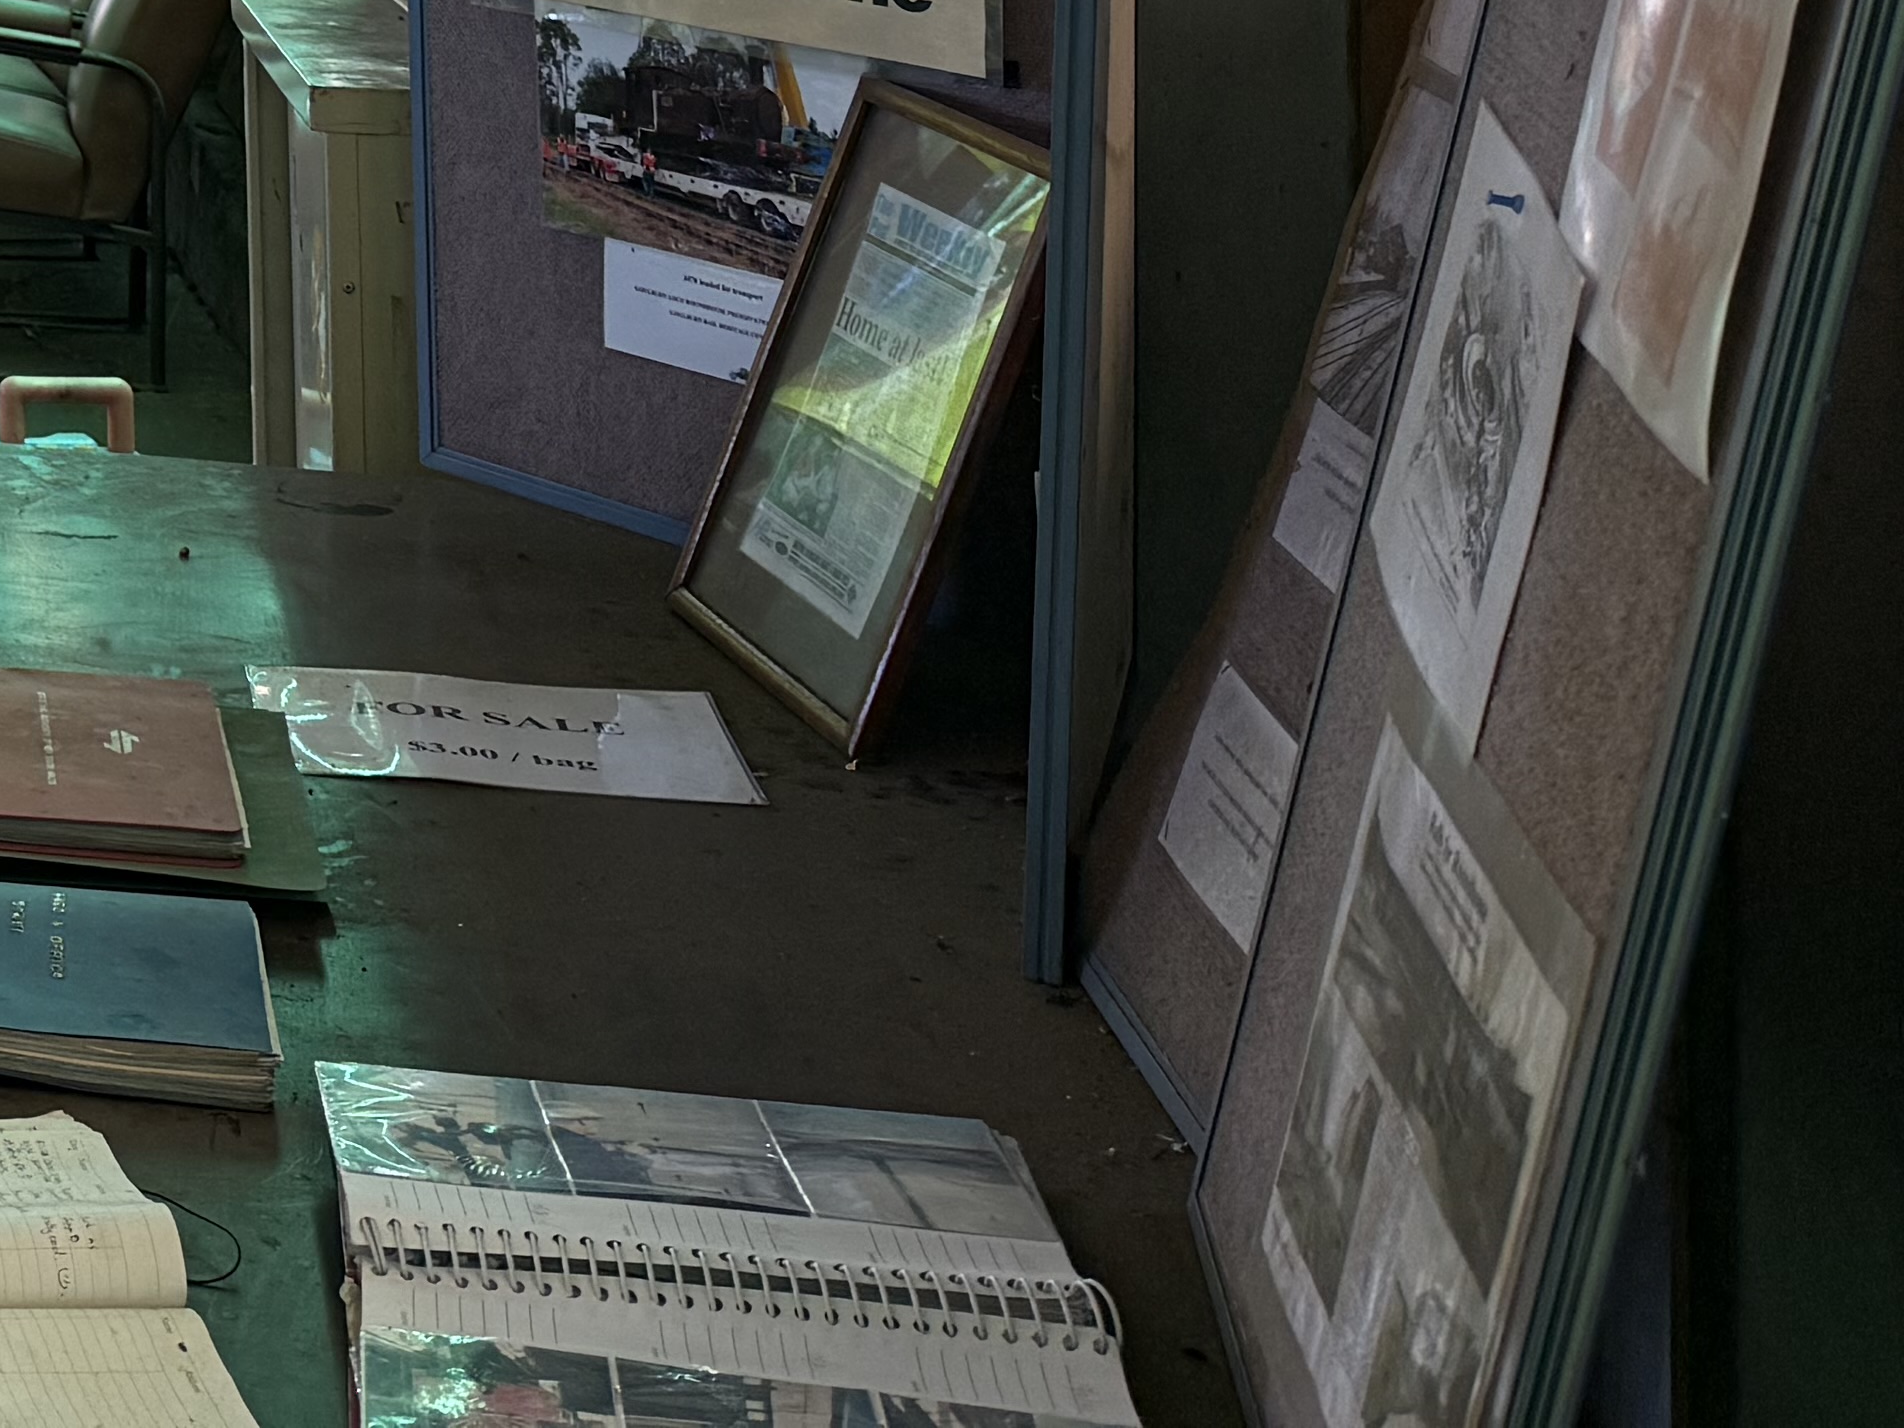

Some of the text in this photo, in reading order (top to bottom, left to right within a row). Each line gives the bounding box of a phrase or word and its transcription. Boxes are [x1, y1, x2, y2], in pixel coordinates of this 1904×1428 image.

[836, 295, 889, 352] Home
[888, 333, 911, 364] at
[355, 701, 625, 736] FOR SALE
[407, 739, 499, 761] $3.00
[532, 754, 598, 772] bag
